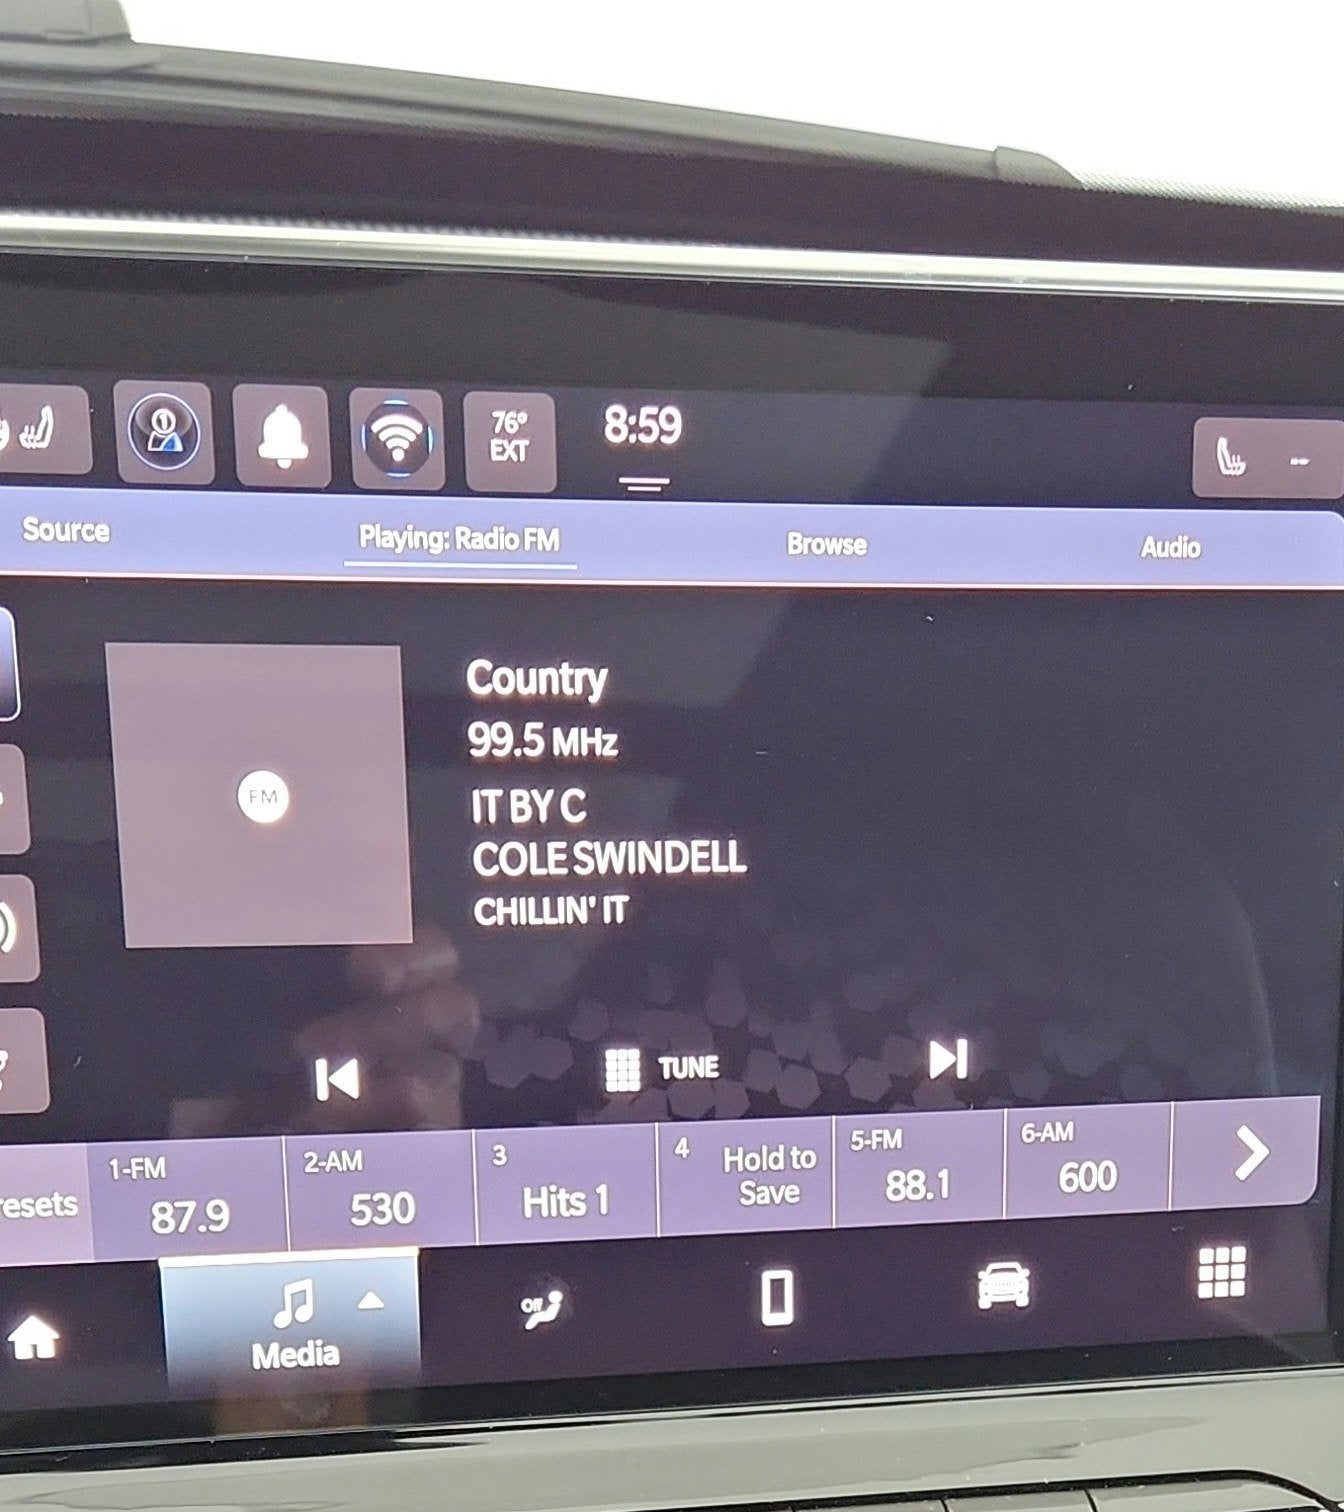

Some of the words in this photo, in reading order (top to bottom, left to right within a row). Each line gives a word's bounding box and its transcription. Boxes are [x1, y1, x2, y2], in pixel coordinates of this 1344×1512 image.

[603, 405, 684, 447] 8:59
[489, 439, 530, 463] EXT
[22, 516, 111, 544] Source
[359, 523, 451, 554] Playing:
[455, 525, 520, 552] Radio
[523, 527, 561, 553] FM
[786, 532, 869, 557] Browse
[1140, 534, 1203, 560] Audio
[466, 658, 610, 704] Country
[467, 721, 545, 758] 99.5
[553, 727, 620, 758] MHz
[247, 787, 278, 805] FM
[471, 788, 504, 824] IT
[509, 788, 554, 824] BY
[559, 787, 587, 823] C
[472, 841, 568, 877] COLE
[572, 839, 748, 876] SWINDELL
[473, 896, 597, 927] CHILLIN'
[602, 895, 630, 925] IT
[658, 1054, 720, 1080] TUNE
[850, 1128, 903, 1152] 5-FM
[1021, 1121, 1075, 1145] 6-AM
[304, 1149, 364, 1174] 2-AM
[491, 1144, 508, 1167] 3
[674, 1137, 690, 1160] 4
[723, 1146, 783, 1174] Hold
[789, 1146, 817, 1171] to
[109, 1156, 167, 1181] 1-FM
[1059, 1160, 1118, 1195] 600
[739, 1180, 801, 1207] Save
[885, 1168, 951, 1202] 88.1
[350, 1191, 416, 1228] 530
[522, 1185, 587, 1219] Hits
[594, 1183, 609, 1215] 1
[150, 1199, 231, 1235] 87.9
[251, 1340, 341, 1370] Media
